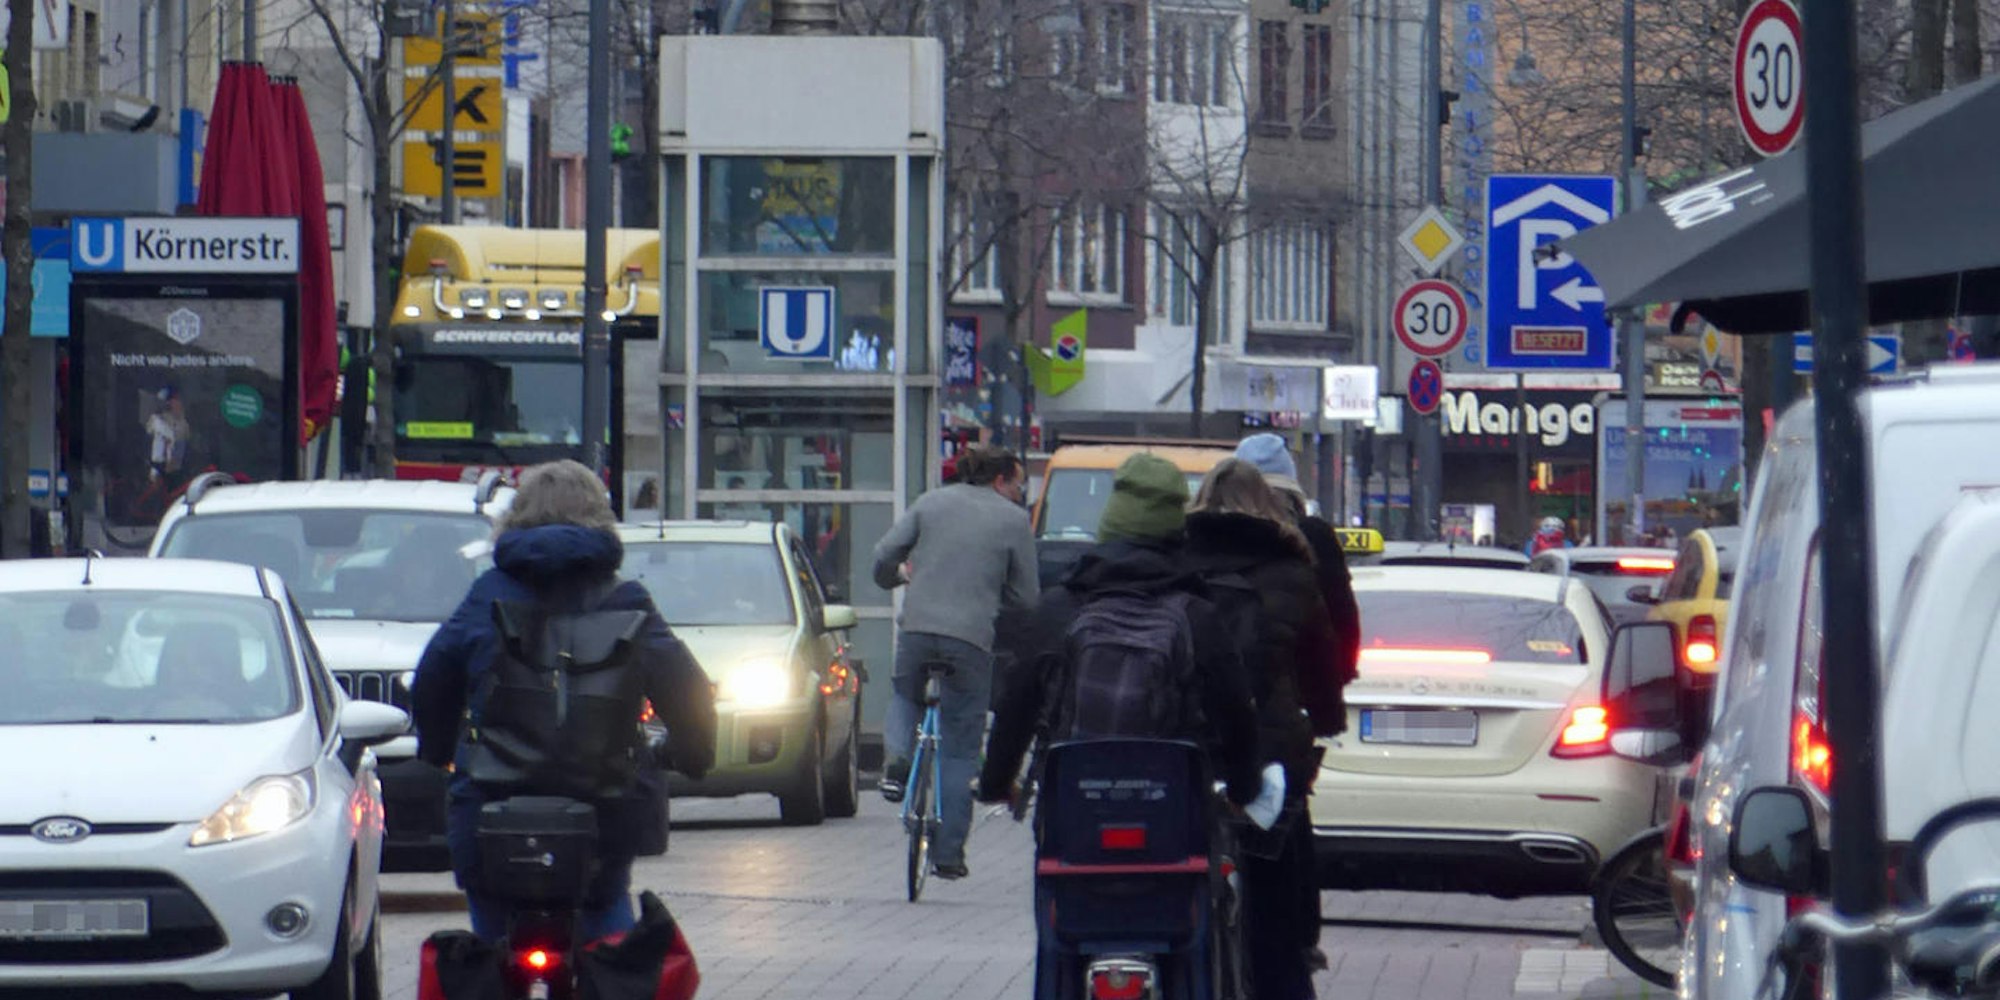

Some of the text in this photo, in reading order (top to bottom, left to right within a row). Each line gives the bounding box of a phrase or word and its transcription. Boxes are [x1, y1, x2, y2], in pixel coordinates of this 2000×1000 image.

[1750, 42, 1794, 109] 30
[79, 222, 289, 266] U Körnerstr.
[767, 292, 826, 354] U
[1409, 302, 1452, 336] 30
[111, 354, 145, 366] Nicht
[147, 355, 169, 366] wie
[170, 354, 206, 368] jedes
[44, 821, 77, 837] Ford
